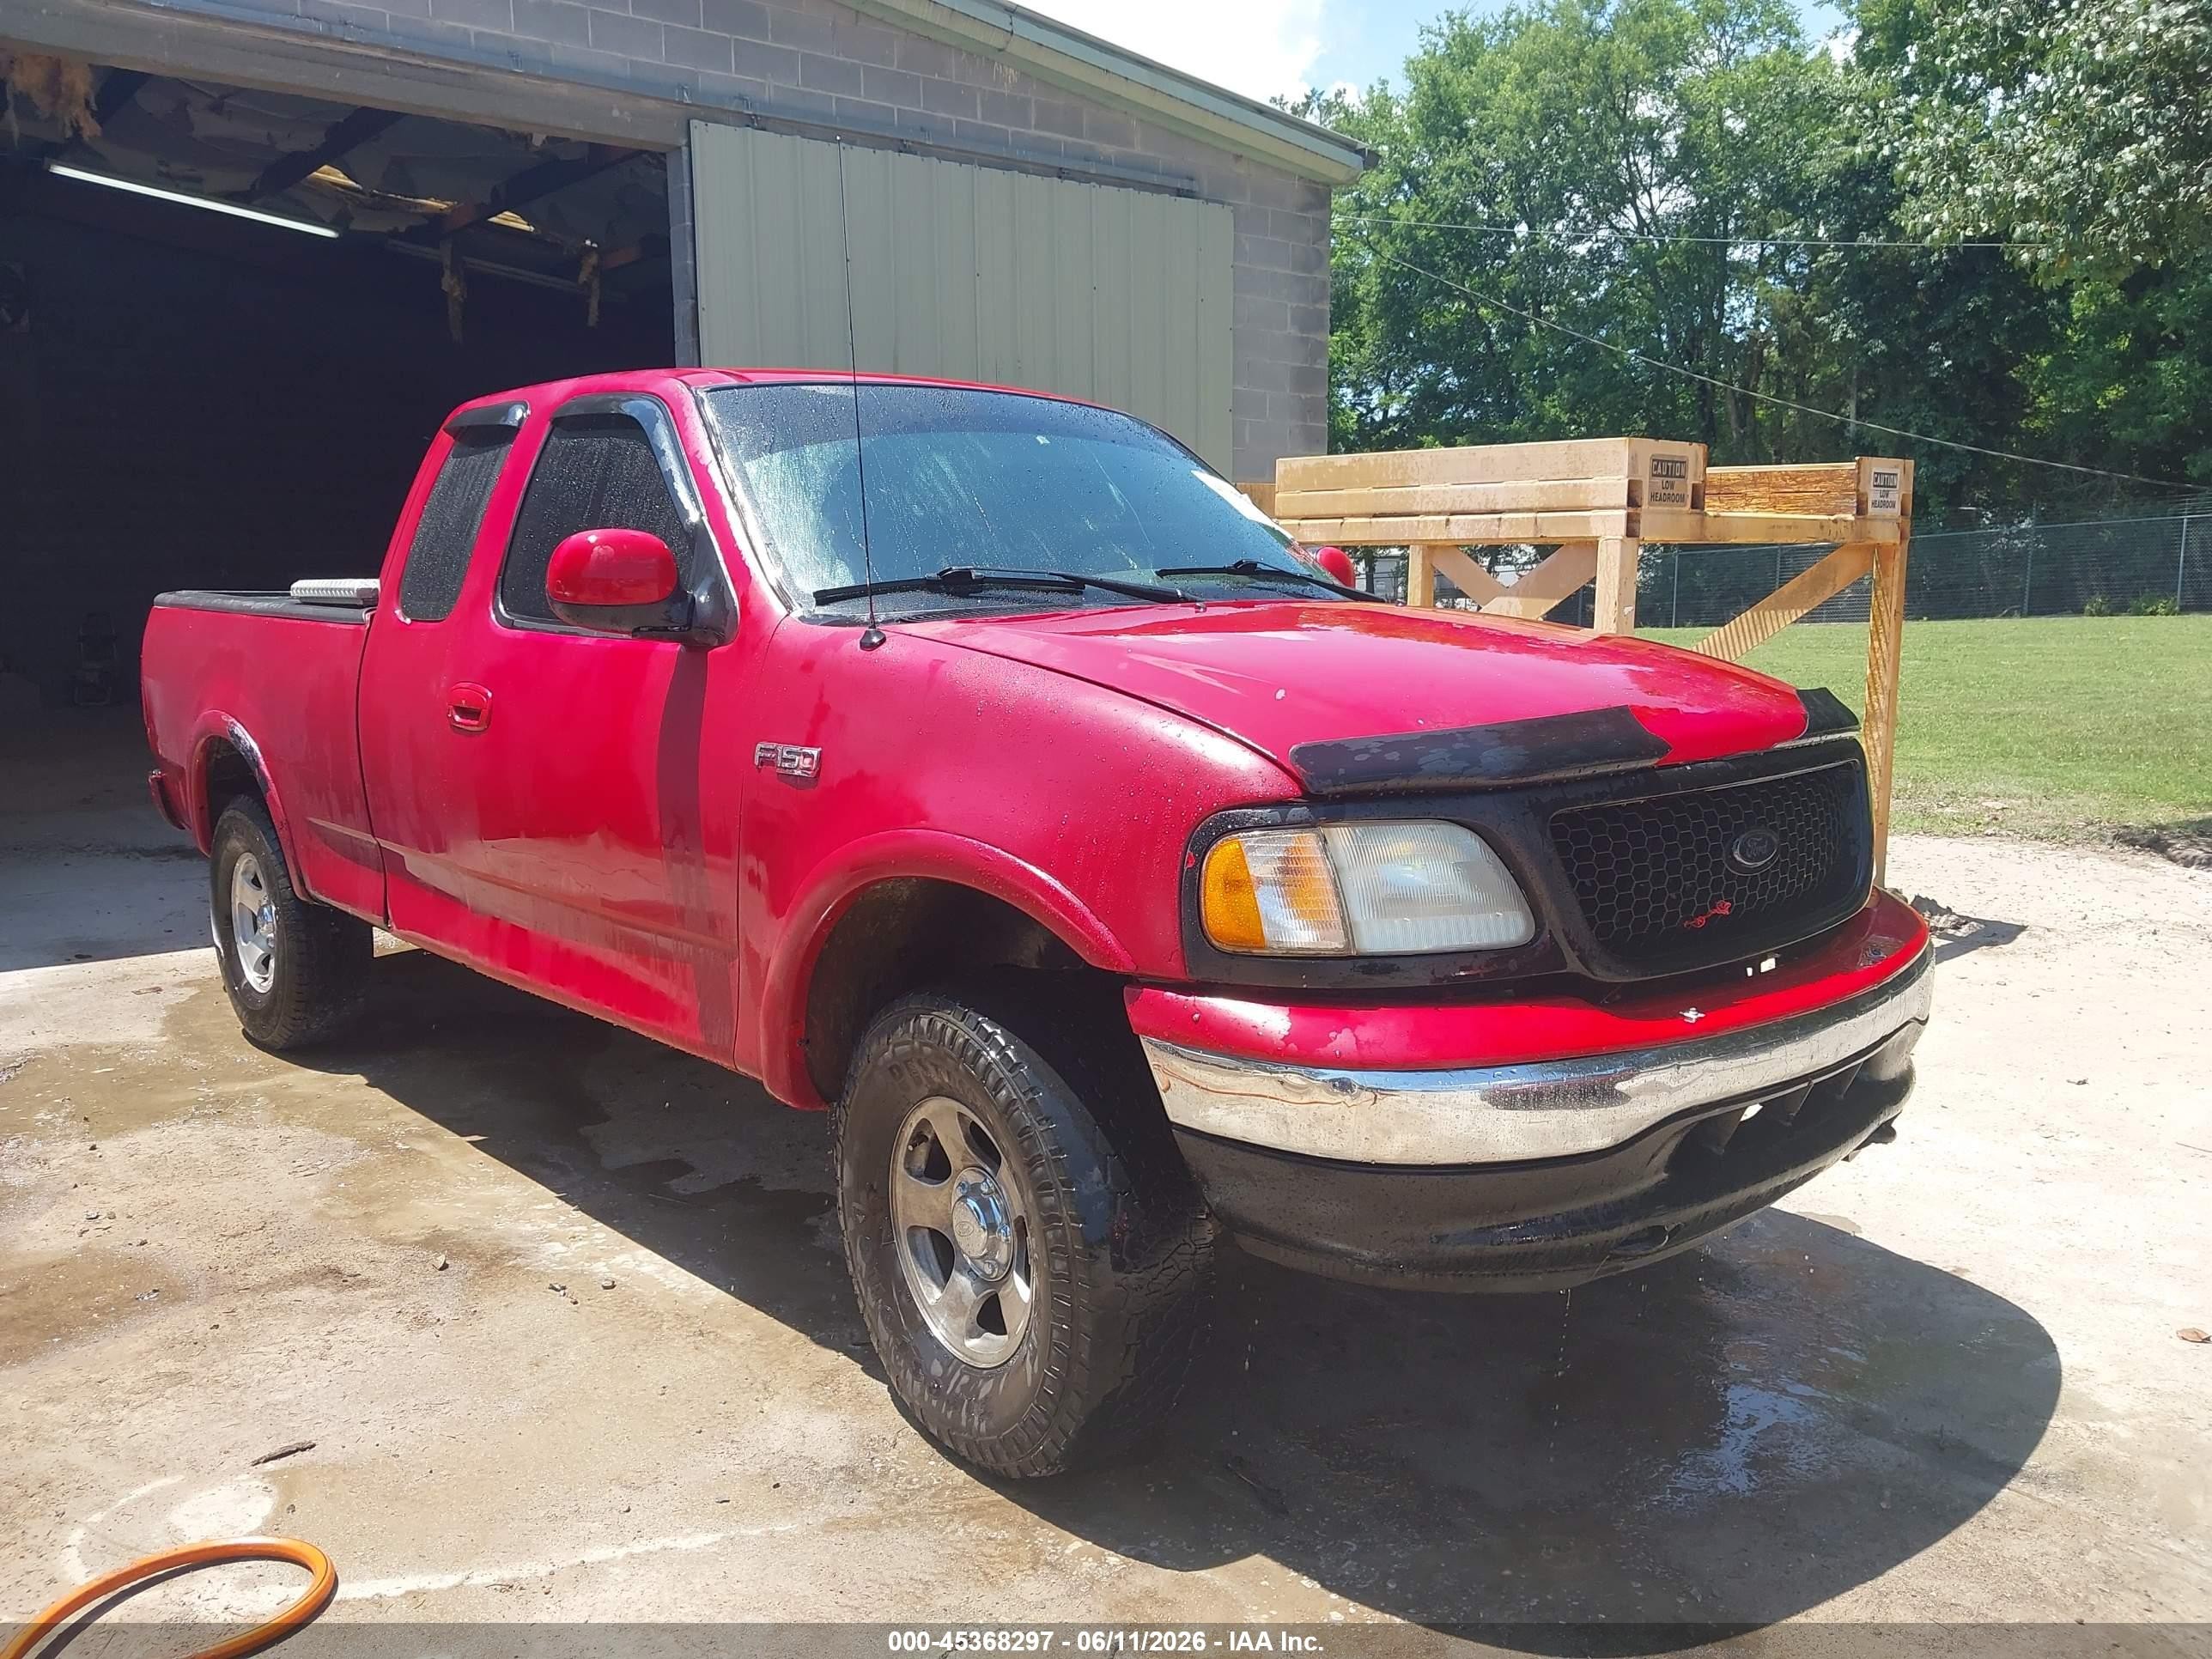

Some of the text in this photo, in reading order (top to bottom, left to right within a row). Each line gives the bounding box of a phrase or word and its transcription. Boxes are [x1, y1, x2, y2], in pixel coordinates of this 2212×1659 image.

[1652, 460, 1686, 477] CAUTION
[1662, 480, 1675, 490] LOW
[1874, 473, 1897, 487] CAUTION
[1650, 492, 1686, 503] HEADROOM
[1871, 500, 1896, 508] HEADROOM
